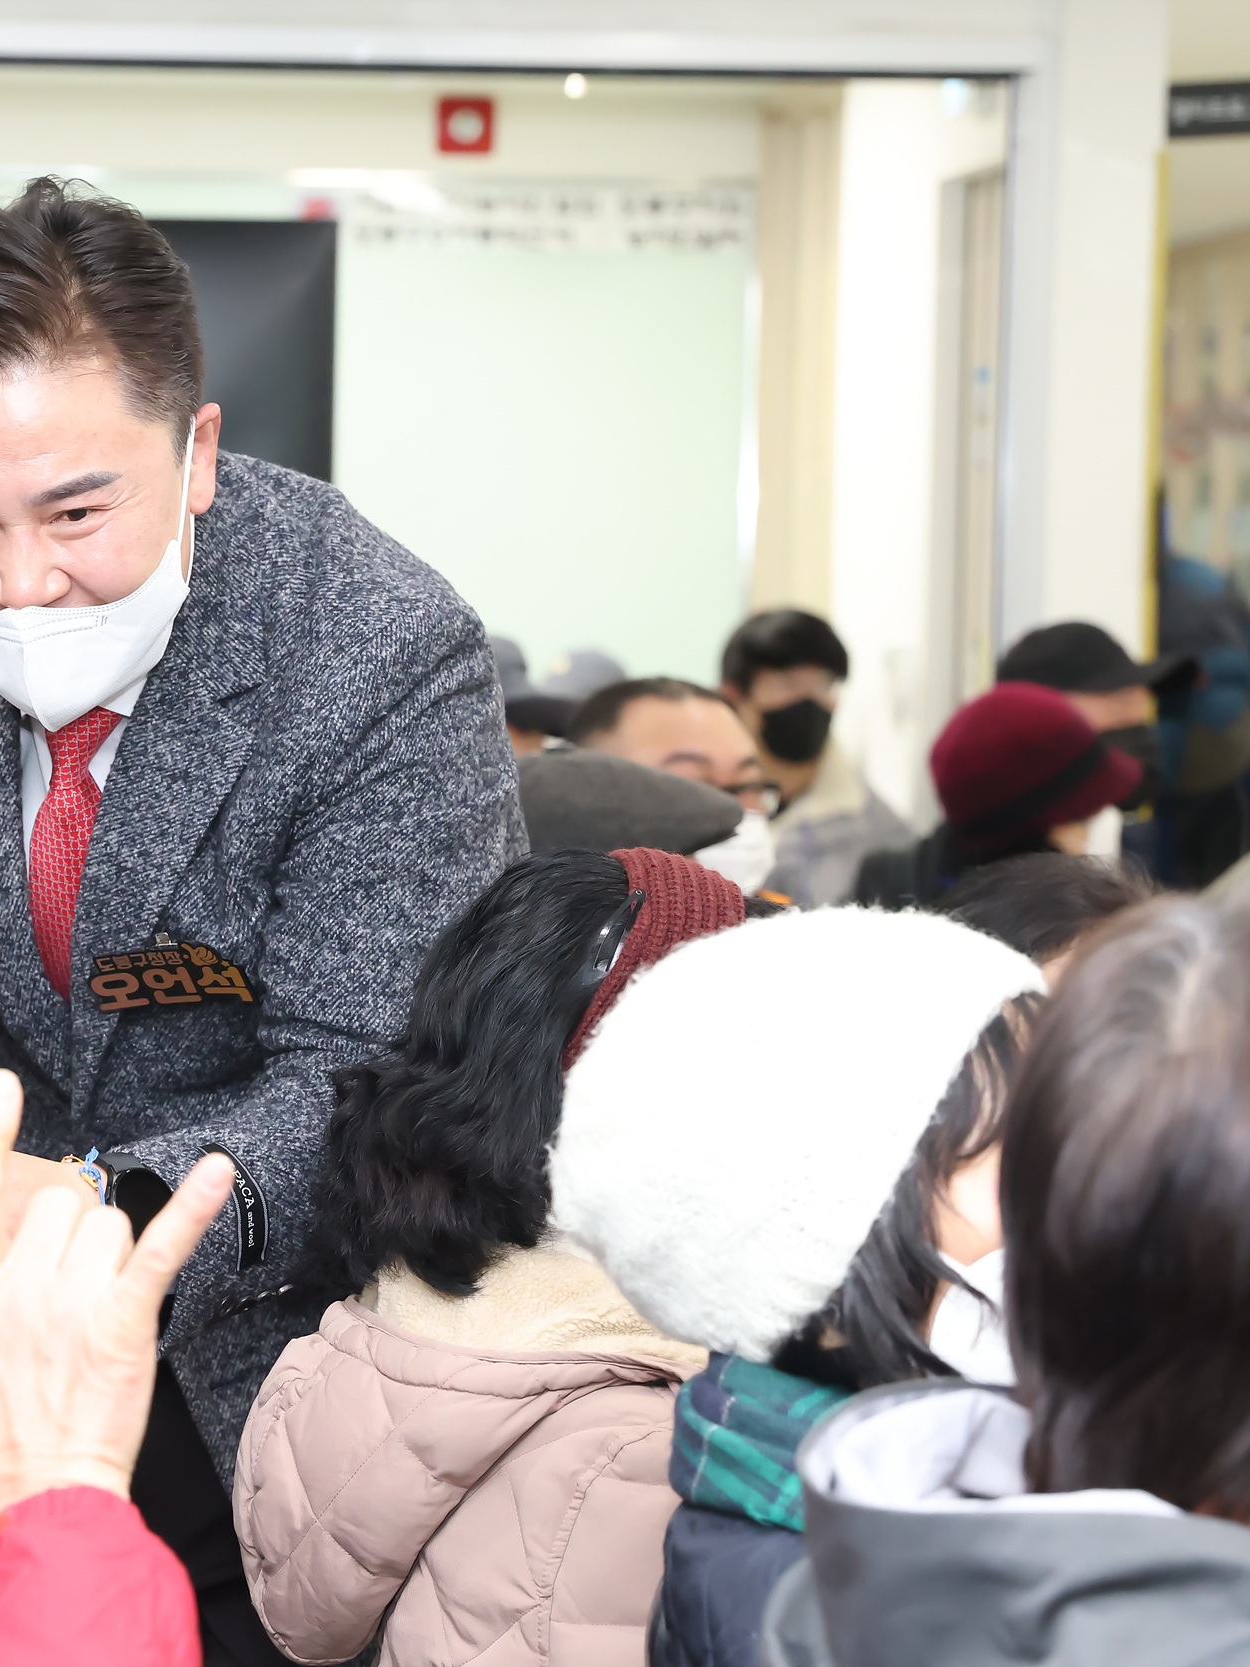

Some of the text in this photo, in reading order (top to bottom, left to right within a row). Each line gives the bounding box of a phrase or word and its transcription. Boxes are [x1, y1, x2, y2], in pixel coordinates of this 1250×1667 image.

[96, 951, 184, 972] 도봉구청장
[91, 966, 253, 1010] 오언석
[230, 1162, 255, 1209] PACA
